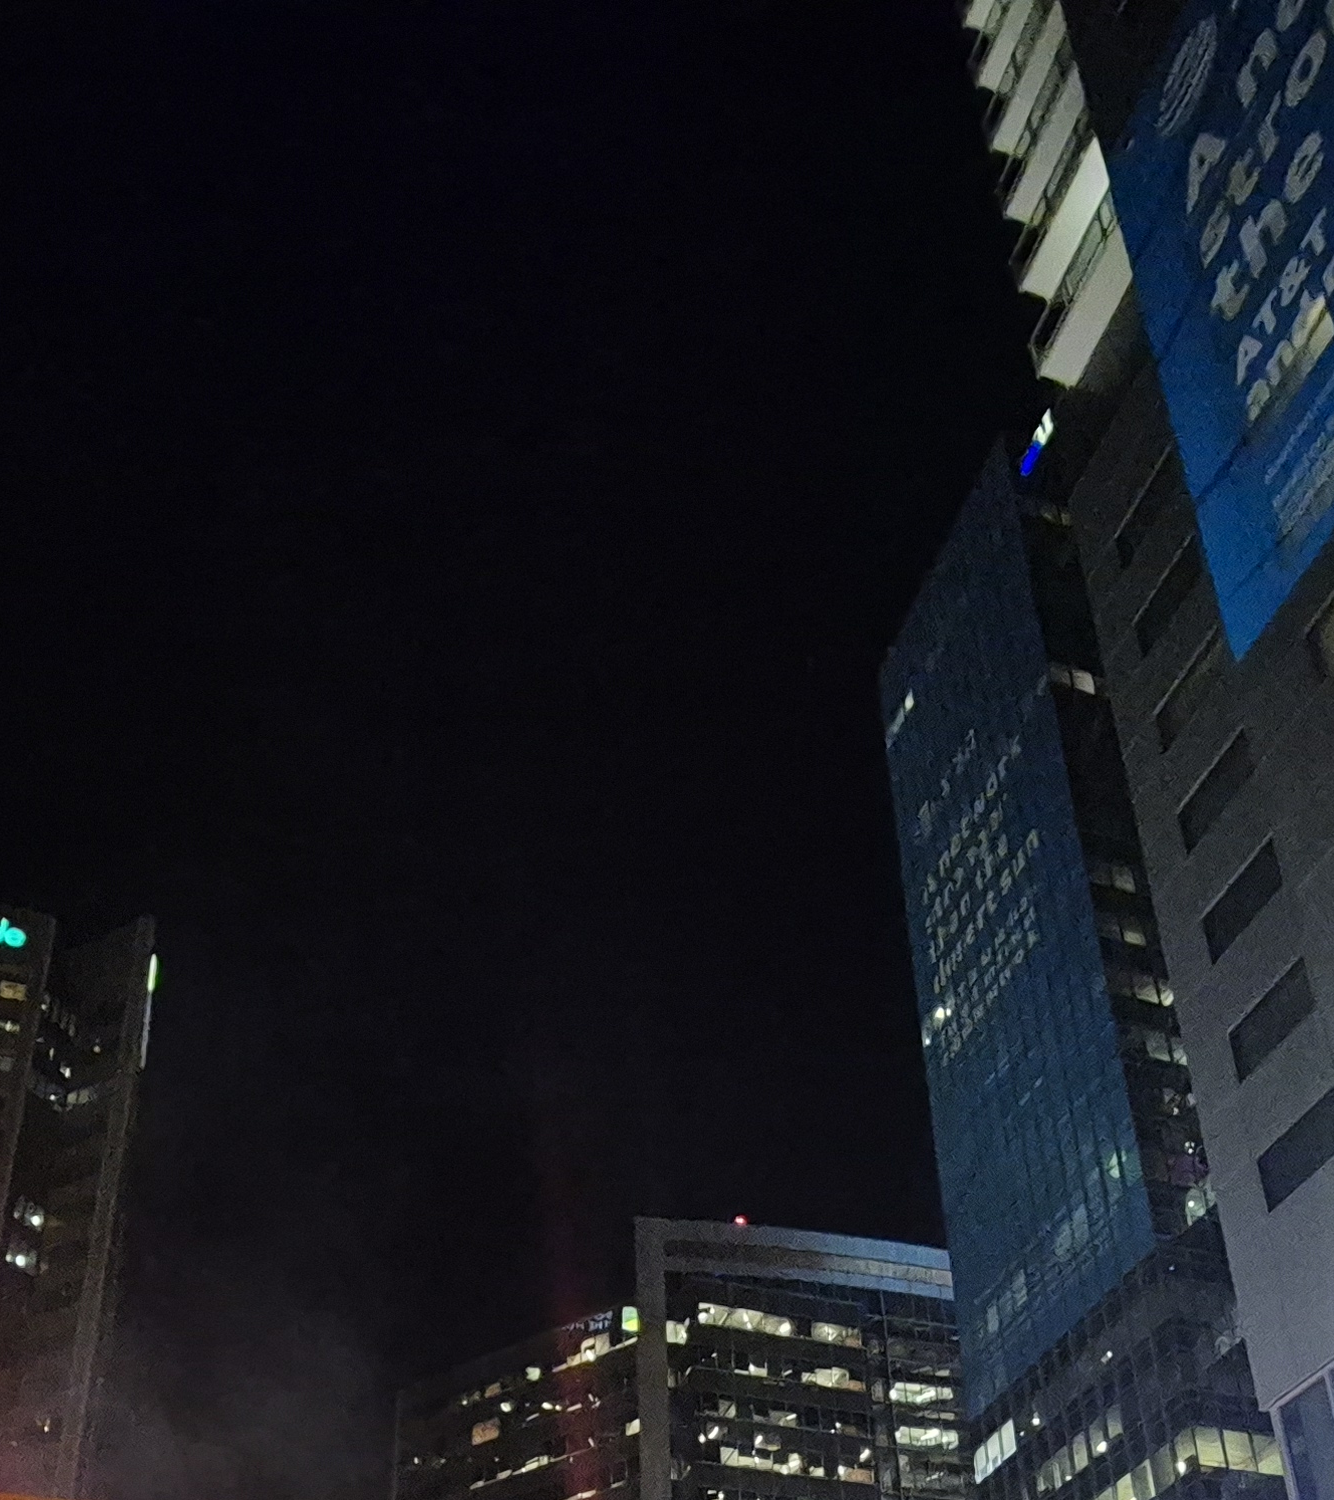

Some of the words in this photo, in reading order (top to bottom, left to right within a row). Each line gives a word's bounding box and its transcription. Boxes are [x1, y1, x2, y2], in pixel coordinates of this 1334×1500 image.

[1187, 131, 1226, 213] A
[1210, 131, 1325, 321] the
[1236, 205, 1329, 386] AT&T
